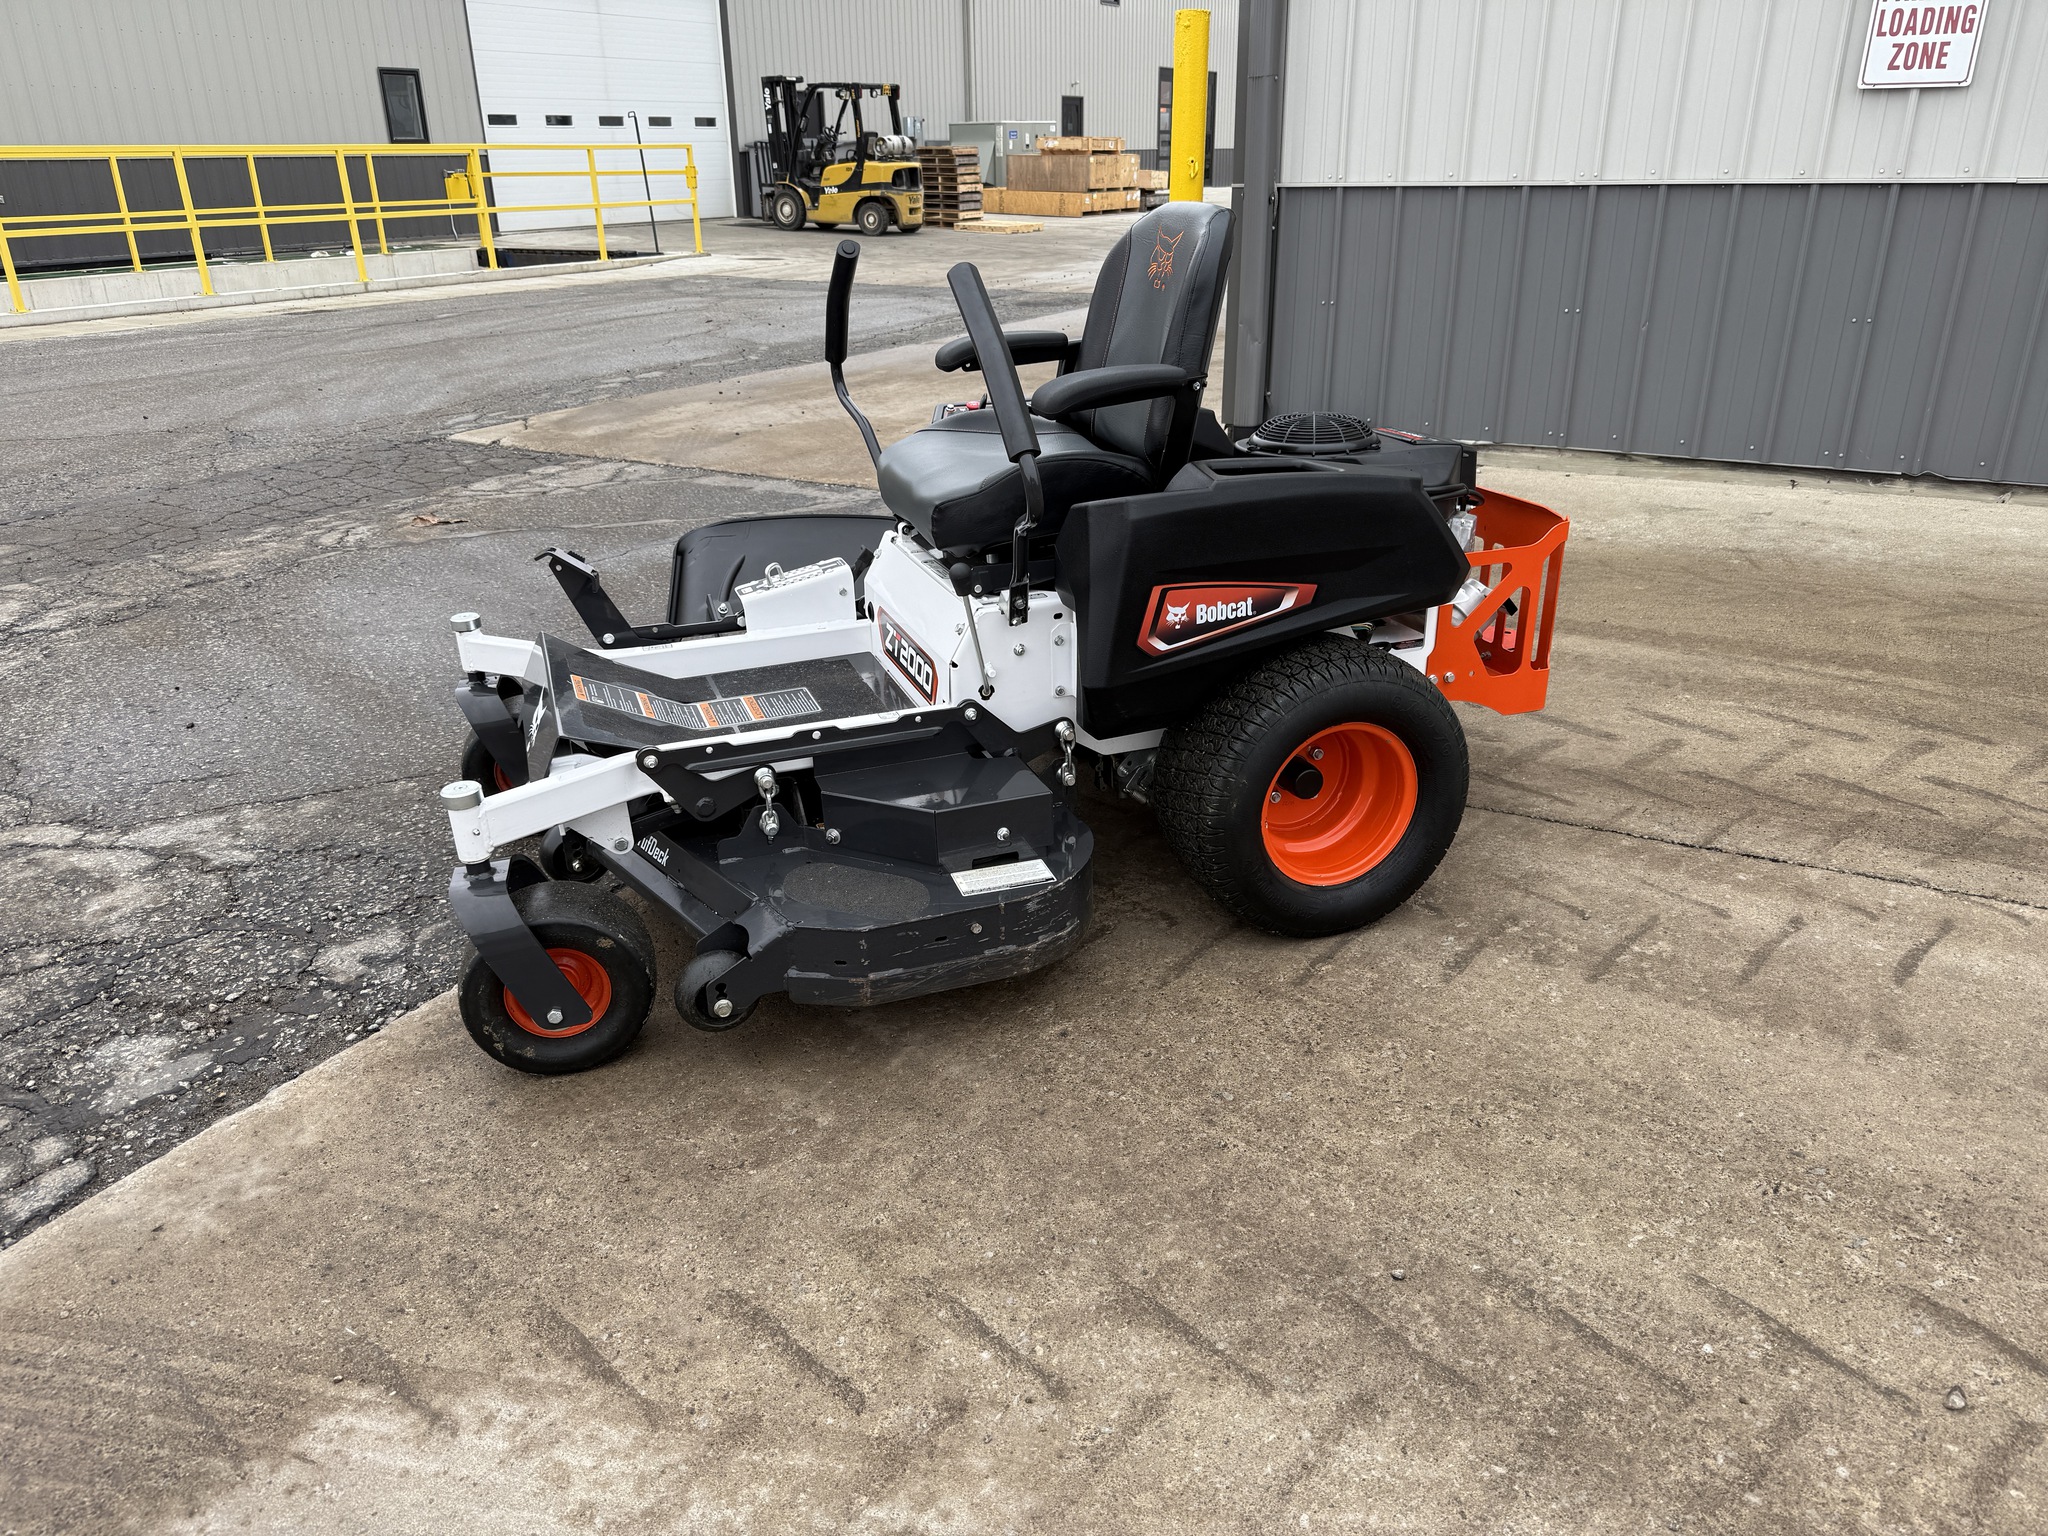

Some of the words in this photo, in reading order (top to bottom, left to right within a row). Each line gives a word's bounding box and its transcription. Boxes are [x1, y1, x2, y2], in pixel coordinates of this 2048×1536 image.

[1876, 4, 1978, 37] LOADING
[1887, 41, 1952, 71] ZONE
[1196, 596, 1253, 625] Bobcat
[885, 622, 932, 695] ZT2000
